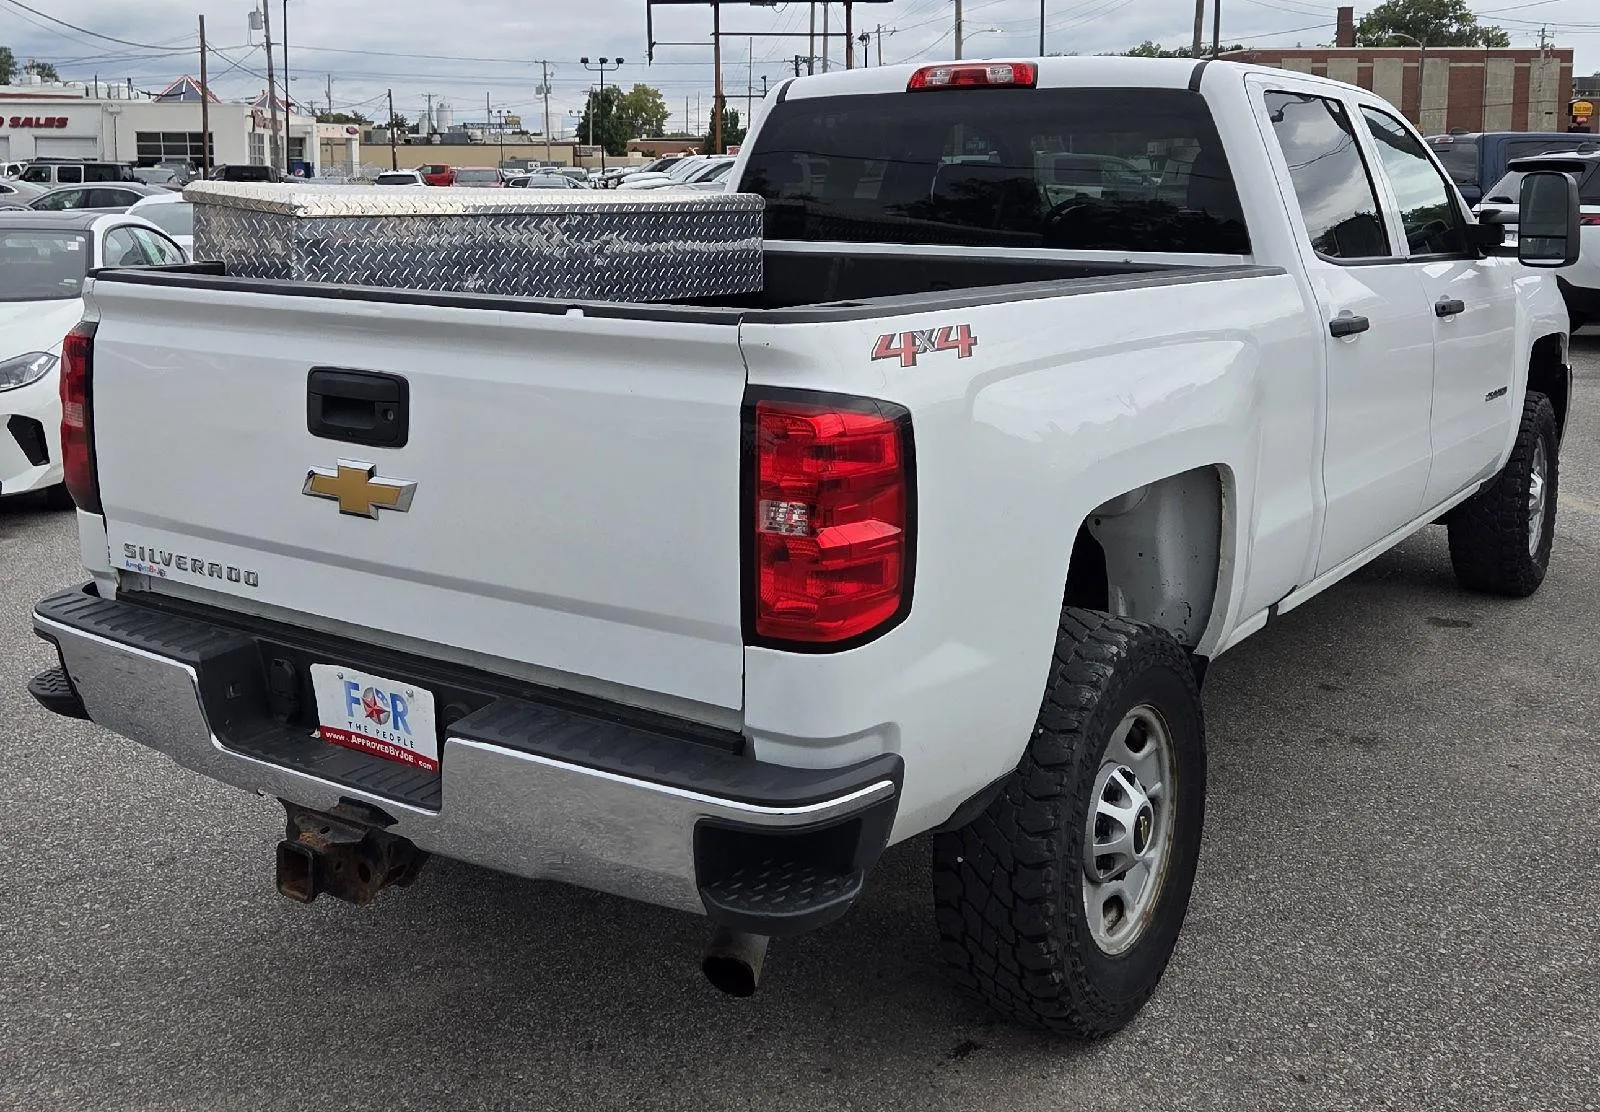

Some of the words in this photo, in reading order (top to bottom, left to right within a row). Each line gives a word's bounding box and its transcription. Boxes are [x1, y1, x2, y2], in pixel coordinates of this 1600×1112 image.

[9, 116, 69, 129] SALES
[124, 543, 259, 588] SILVERADO
[348, 721, 369, 734] THE
[376, 729, 415, 749] PEOPLE
